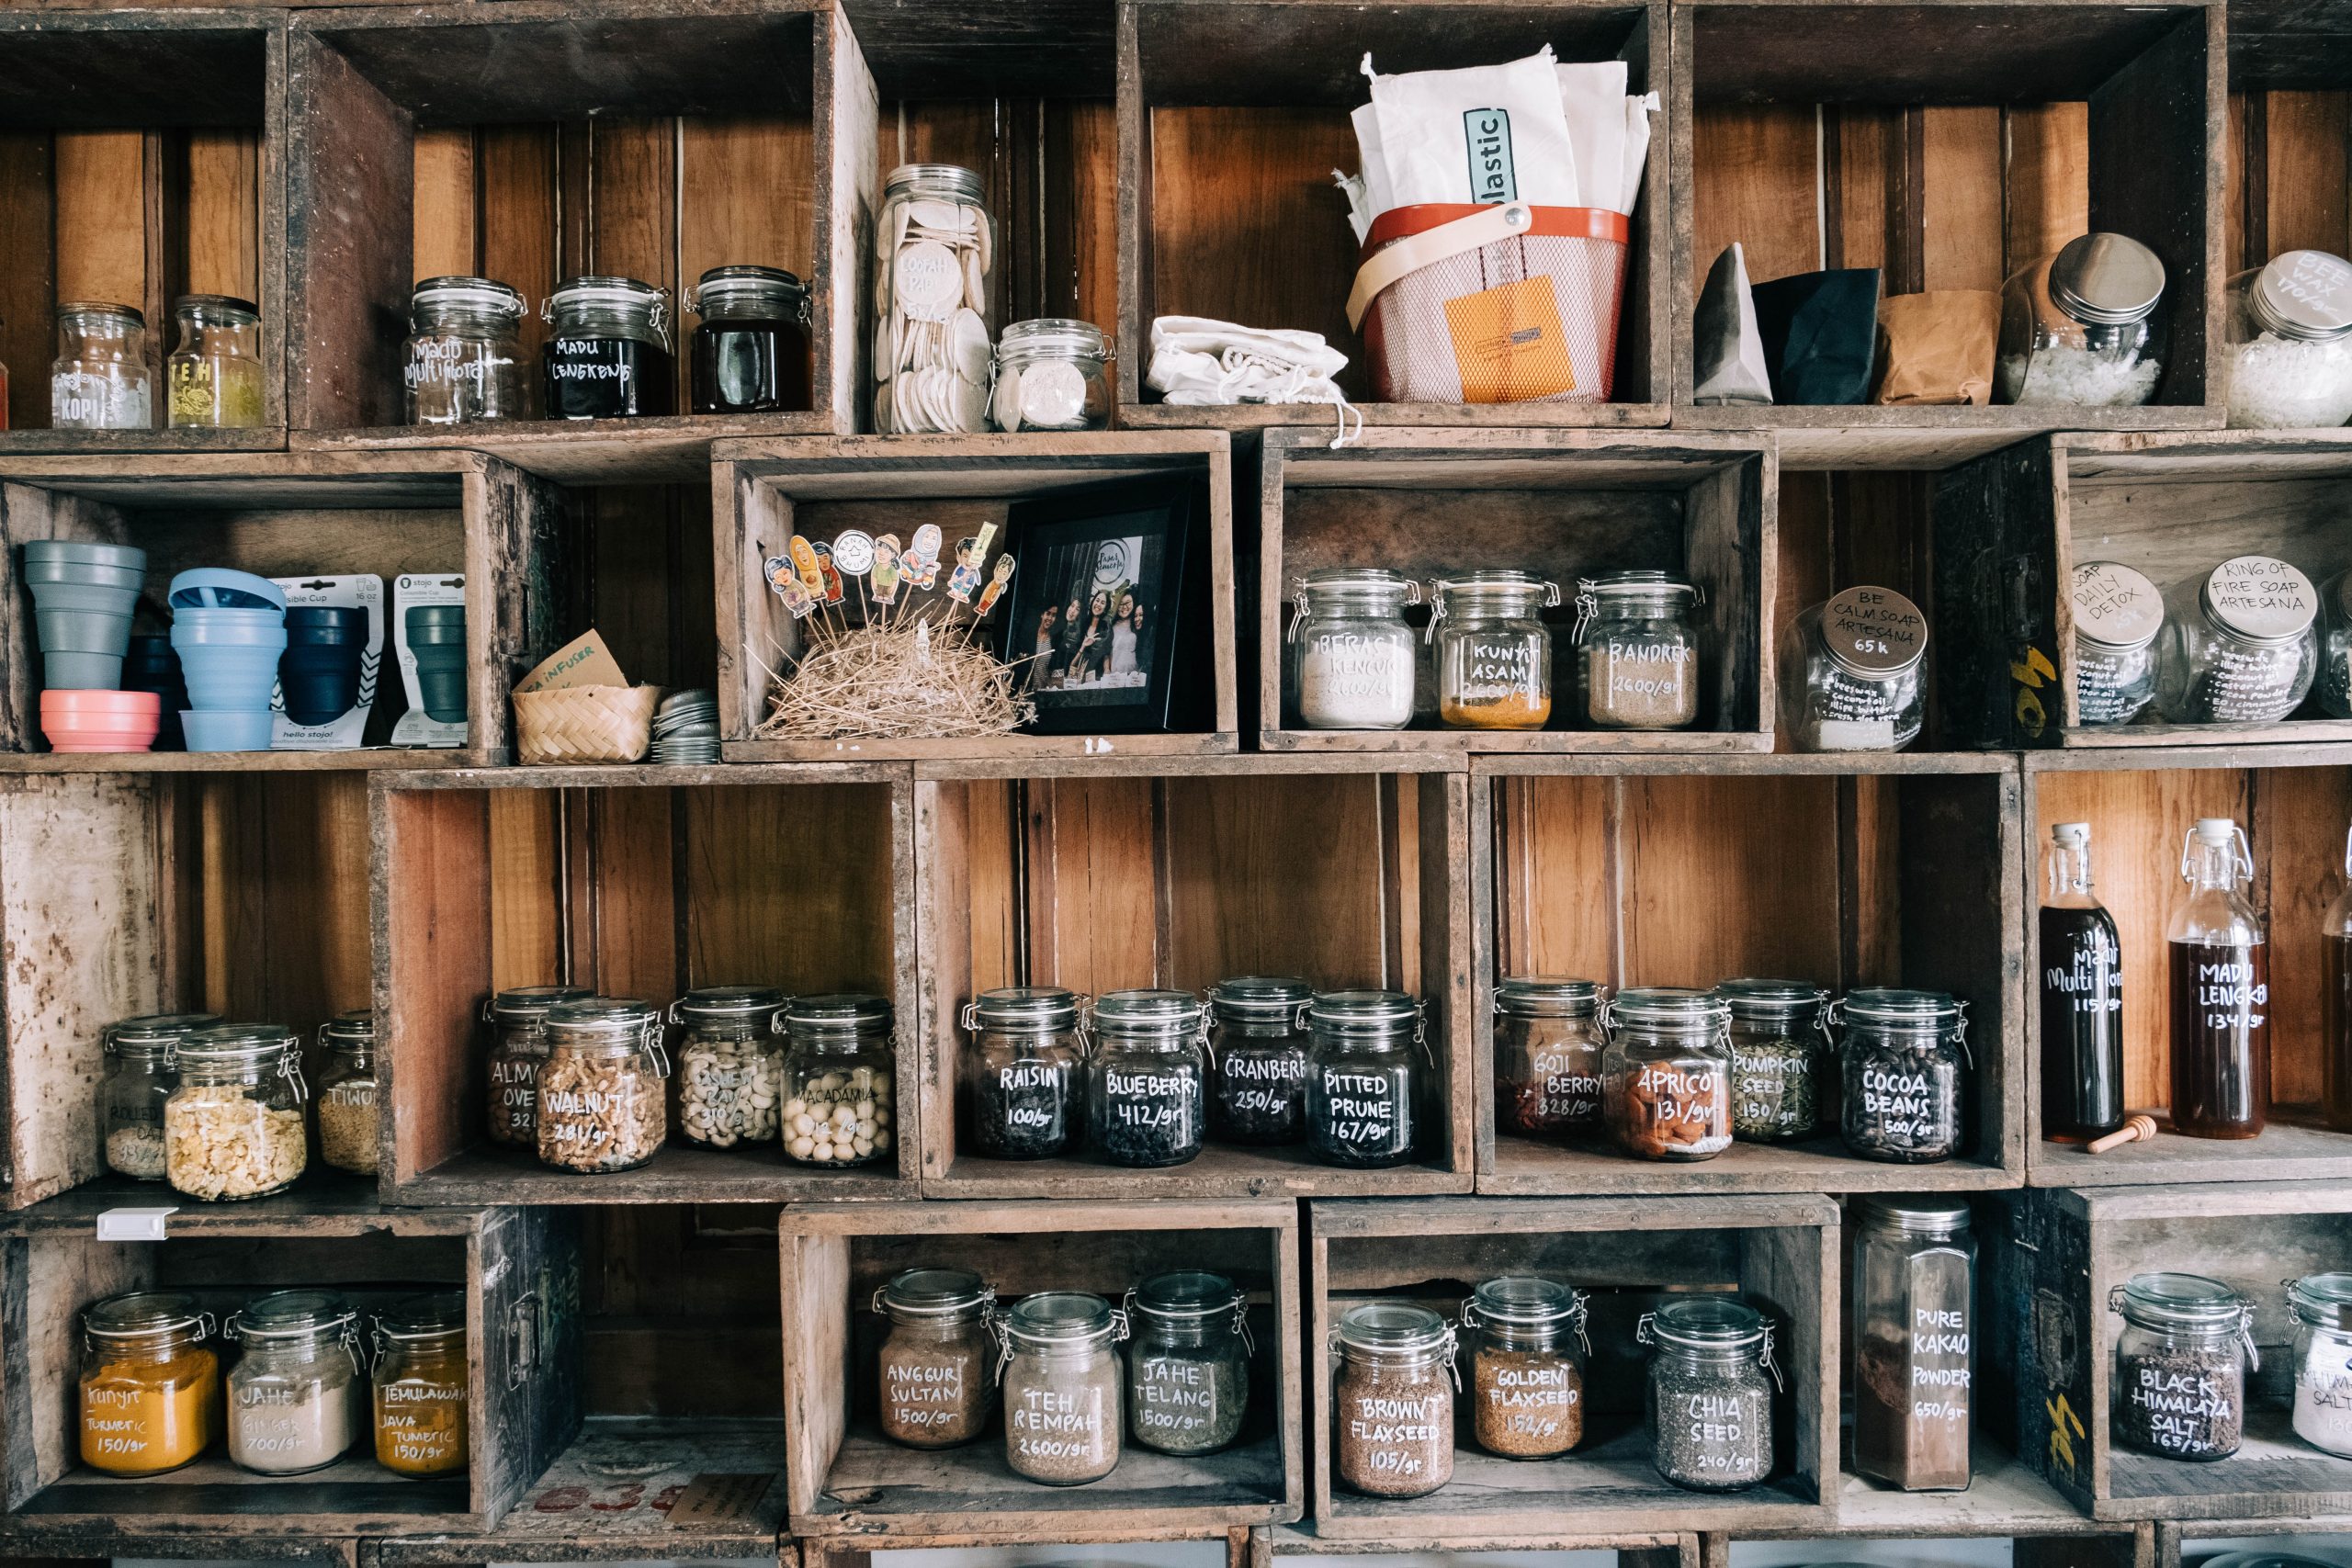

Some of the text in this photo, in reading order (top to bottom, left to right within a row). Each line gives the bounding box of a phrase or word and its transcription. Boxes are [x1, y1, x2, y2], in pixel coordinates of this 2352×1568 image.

[1477, 118, 1506, 204] lastic
[2296, 252, 2349, 287] BEE
[2291, 266, 2336, 298] WAX
[556, 338, 598, 355] MADU
[171, 362, 211, 383] TEH
[62, 398, 97, 421] KOPI
[2073, 565, 2101, 588] SOAP
[2224, 562, 2290, 578] RING OF
[413, 580, 433, 588] stojo
[2074, 574, 2121, 607] DAILY
[2211, 581, 2300, 595] FIRE SOAP
[310, 594, 327, 603] Cup
[1859, 592, 1884, 605] BE
[2088, 587, 2143, 620] DETOX
[2220, 597, 2306, 610] ARTESANA
[1833, 604, 1920, 627] CALM SOAP
[1835, 618, 1915, 647] ARTESANA
[1319, 632, 1385, 655] BERAS
[1610, 642, 1691, 663] BANDREK
[1472, 663, 1526, 682] ASAM
[2075, 660, 2116, 671] eeswax
[2214, 681, 2254, 690] castor
[2217, 671, 2263, 682] coconut
[1612, 678, 1679, 698] 2600/gr
[1833, 681, 1878, 697] beeswax
[2213, 688, 2246, 699] cocoa
[1872, 697, 1886, 705] oil
[307, 731, 334, 739] stojo!
[2199, 964, 2254, 983] MADU
[2207, 1014, 2265, 1030] 134/gr
[1533, 1052, 1570, 1074] GOJI
[1733, 1055, 1808, 1075] PUMPKIN
[1000, 1066, 1058, 1091] RAISIN
[1106, 1072, 1198, 1098] BLUEBERRY
[1324, 1072, 1388, 1095] PITTED
[1547, 1073, 1603, 1095] BERRY
[1637, 1070, 1724, 1096] APRICOT
[1742, 1077, 1785, 1095] SEED
[1863, 1069, 1929, 1096] COCOA
[544, 1089, 625, 1115] WALNUT
[795, 1087, 877, 1105] MACADAMIA
[1235, 1088, 1288, 1114] 250/gr
[1864, 1092, 1930, 1117] BEANS
[110, 1106, 158, 1121] ROLLED
[1008, 1108, 1053, 1128] 100/gr
[1118, 1103, 1182, 1128] 412/gr
[1330, 1098, 1393, 1119] PRUNE
[1657, 1100, 1713, 1124] 131/gr
[1741, 1100, 1796, 1125] 150/gr
[1330, 1120, 1391, 1143] 167/gr
[1884, 1120, 1935, 1137] 500/gr
[1916, 1308, 1963, 1328] PURE
[1913, 1332, 1970, 1355] KAKAO
[887, 1365, 957, 1382] ANGGUR
[1143, 1362, 1200, 1385] JAHE
[1498, 1369, 1563, 1387] GOLDEN
[1912, 1365, 1971, 1388] POWDER
[2141, 1369, 2218, 1398] BLACK
[241, 1386, 294, 1404] JAHE
[890, 1385, 958, 1403] SULTAN
[1024, 1389, 1073, 1413] TEH
[1135, 1384, 1211, 1407] TELANG
[1489, 1388, 1578, 1408] FLAXSEED
[2132, 1387, 2230, 1419] HIMALAYA
[894, 1407, 958, 1427] 1500/gr
[1362, 1397, 1426, 1421] BROWN
[1689, 1394, 1742, 1421] CHIA
[1915, 1401, 1967, 1421] 650/gr
[379, 1415, 416, 1428] JAVA
[1014, 1409, 1100, 1432] REMPAH
[1139, 1409, 1204, 1429] 1500/gr
[2151, 1414, 2199, 1438] SALT
[1351, 1419, 1440, 1443] FLAXSEED
[1690, 1423, 1741, 1443] SEED
[97, 1438, 148, 1452] 150/gr
[394, 1444, 445, 1461] 150/gr
[1020, 1437, 1090, 1458] 2600/gr
[2152, 1432, 2214, 1452] 165/gr
[1370, 1450, 1421, 1474] 105/gr
[1697, 1451, 1754, 1472] 240/gr
